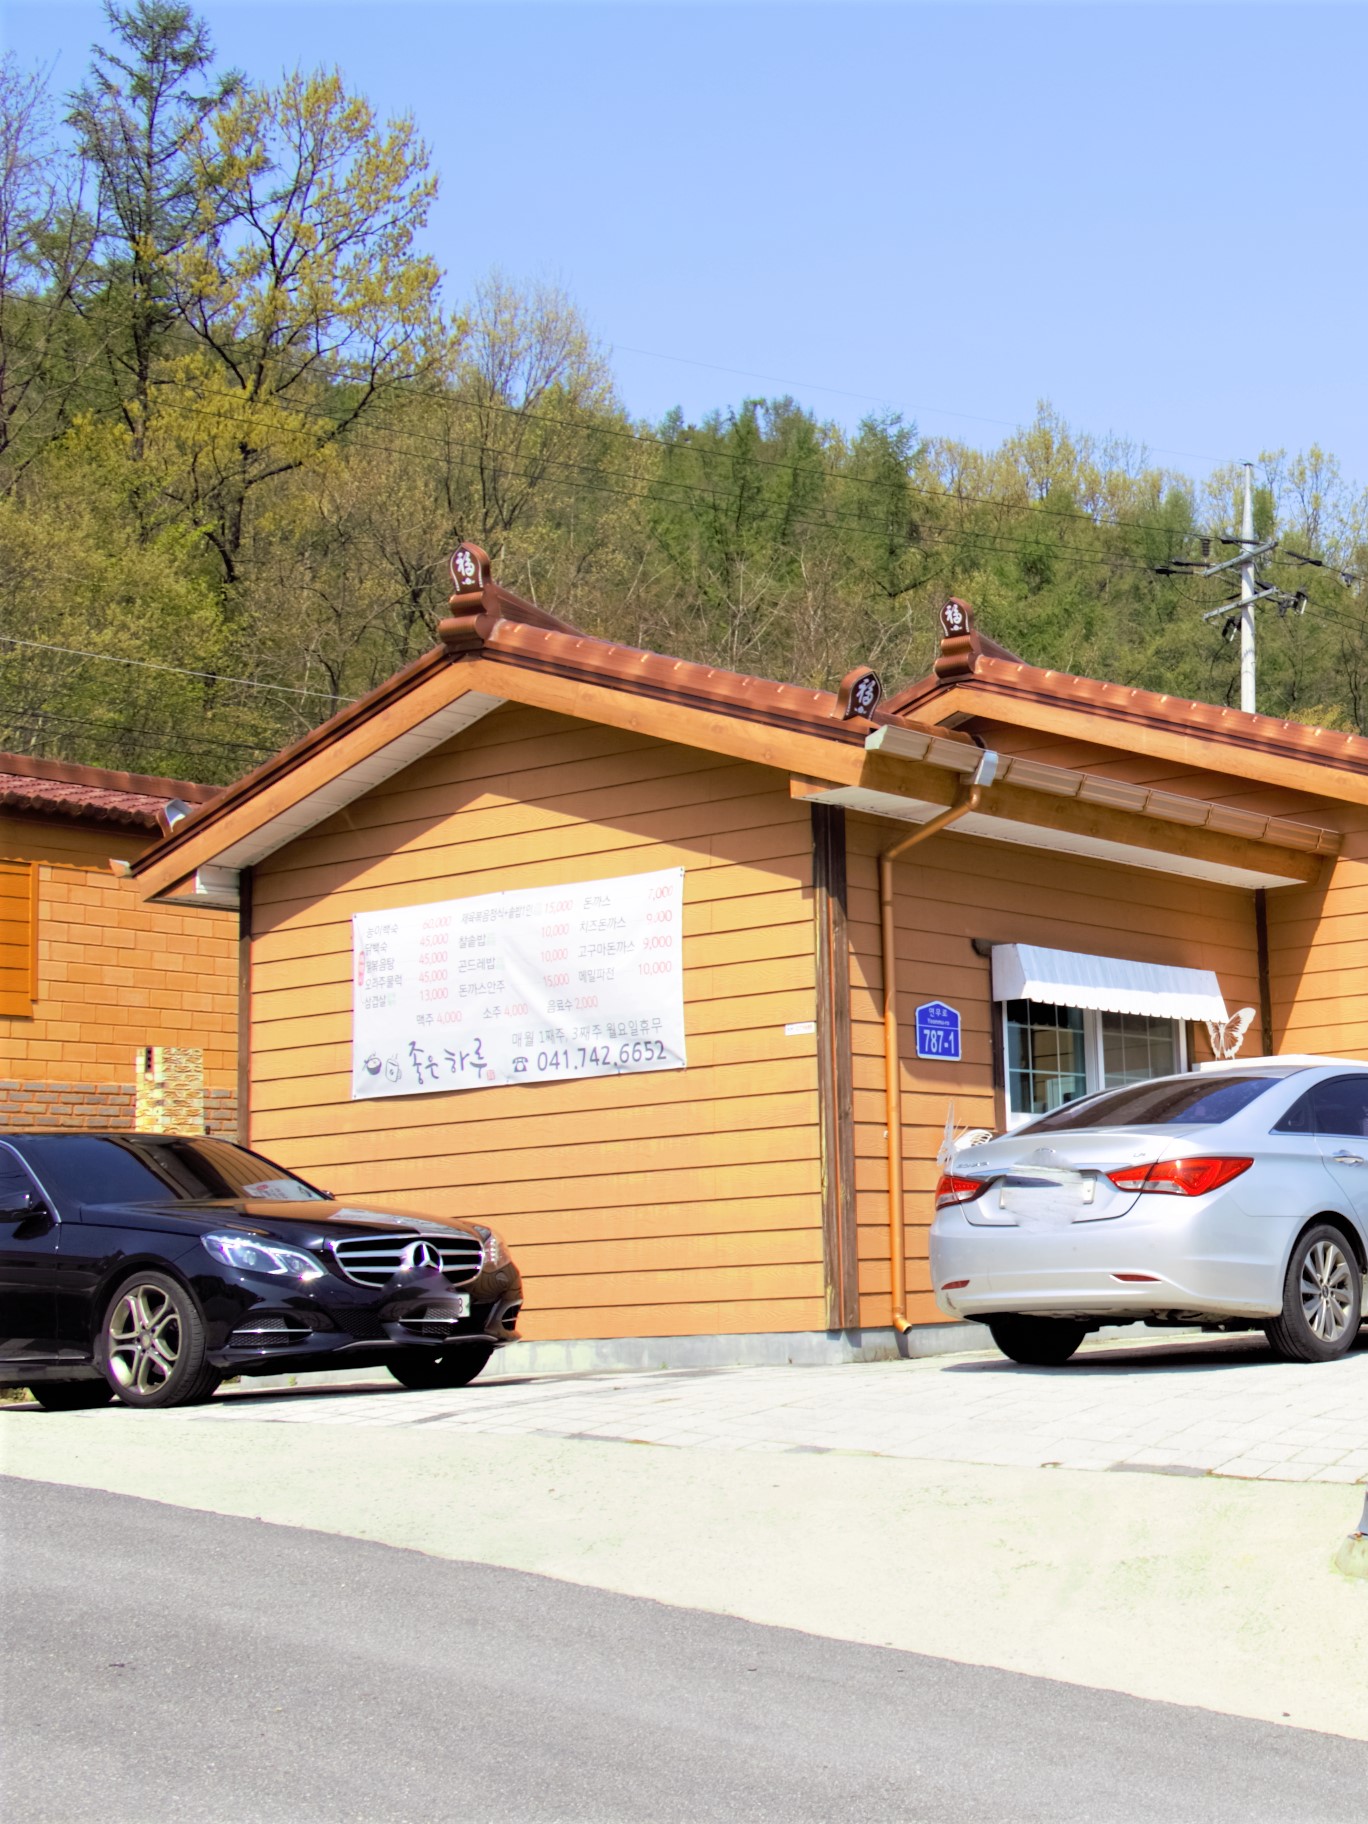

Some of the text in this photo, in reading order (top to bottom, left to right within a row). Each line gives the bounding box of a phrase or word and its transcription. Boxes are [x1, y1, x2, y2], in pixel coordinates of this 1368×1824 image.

[545, 899, 573, 914] 15,000
[583, 895, 612, 910] 돈까스
[541, 923, 569, 938] 10,000
[579, 916, 627, 934] 치즈돈까스
[419, 933, 449, 948] 45,000
[577, 935, 673, 959] 고구마돈까스 9,000
[419, 950, 448, 966] 45,000
[458, 957, 496, 973] 곤드레밥
[540, 948, 568, 963] 10,000
[418, 968, 448, 985] 45,000
[578, 960, 672, 985] 메밀파전 10,000
[458, 973, 570, 998] 돈까스안주 15,000
[364, 994, 387, 1010] 삼겹살
[420, 987, 449, 1002] 13,000
[416, 995, 599, 1026] 맥주 4,000 소주 4,000 음료수 2,000
[928, 1007, 948, 1018] 연무로
[511, 1030, 535, 1048] 매월
[572, 1024, 603, 1042] 3째주
[923, 1029, 955, 1055] 787-1
[407, 1037, 489, 1086] 좋은 하루
[536, 1039, 668, 1072] 041.742.6652
